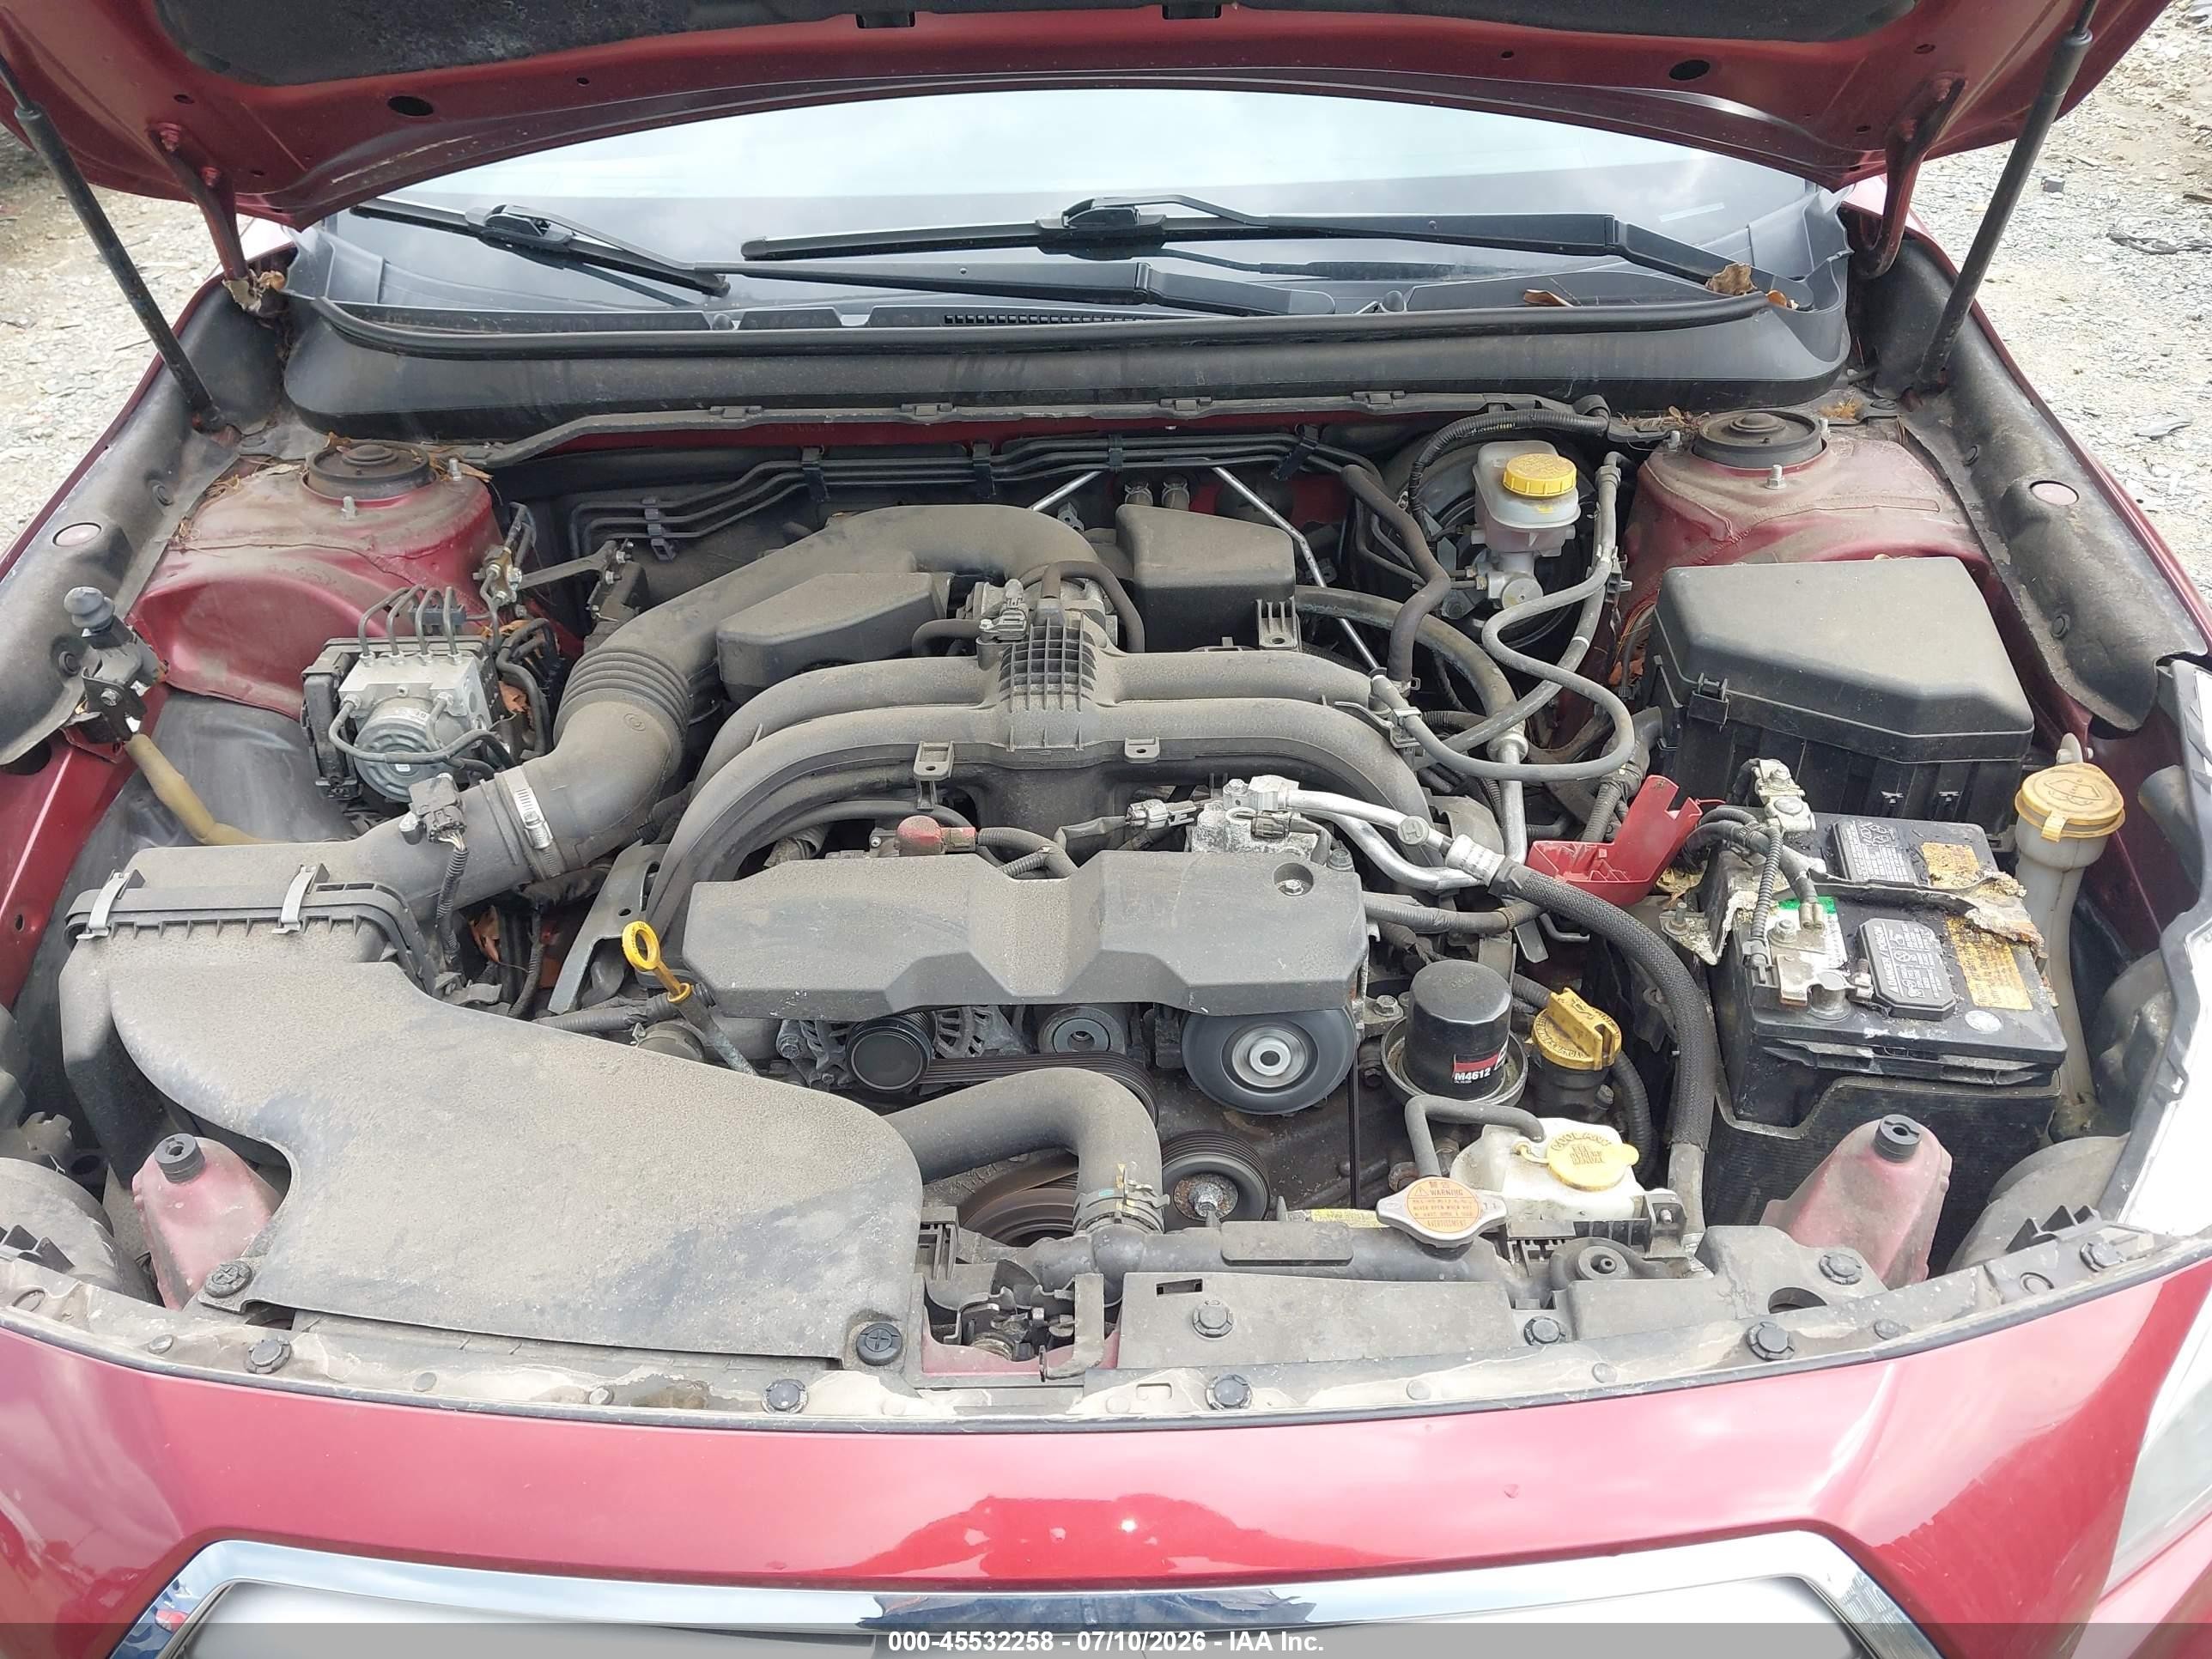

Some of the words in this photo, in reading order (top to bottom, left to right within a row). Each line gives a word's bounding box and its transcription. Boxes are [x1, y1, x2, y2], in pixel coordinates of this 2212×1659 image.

[1873, 927, 1888, 951] POISON
[1882, 957, 1898, 986] DANGER
[1454, 1066, 1491, 1081] M4612
